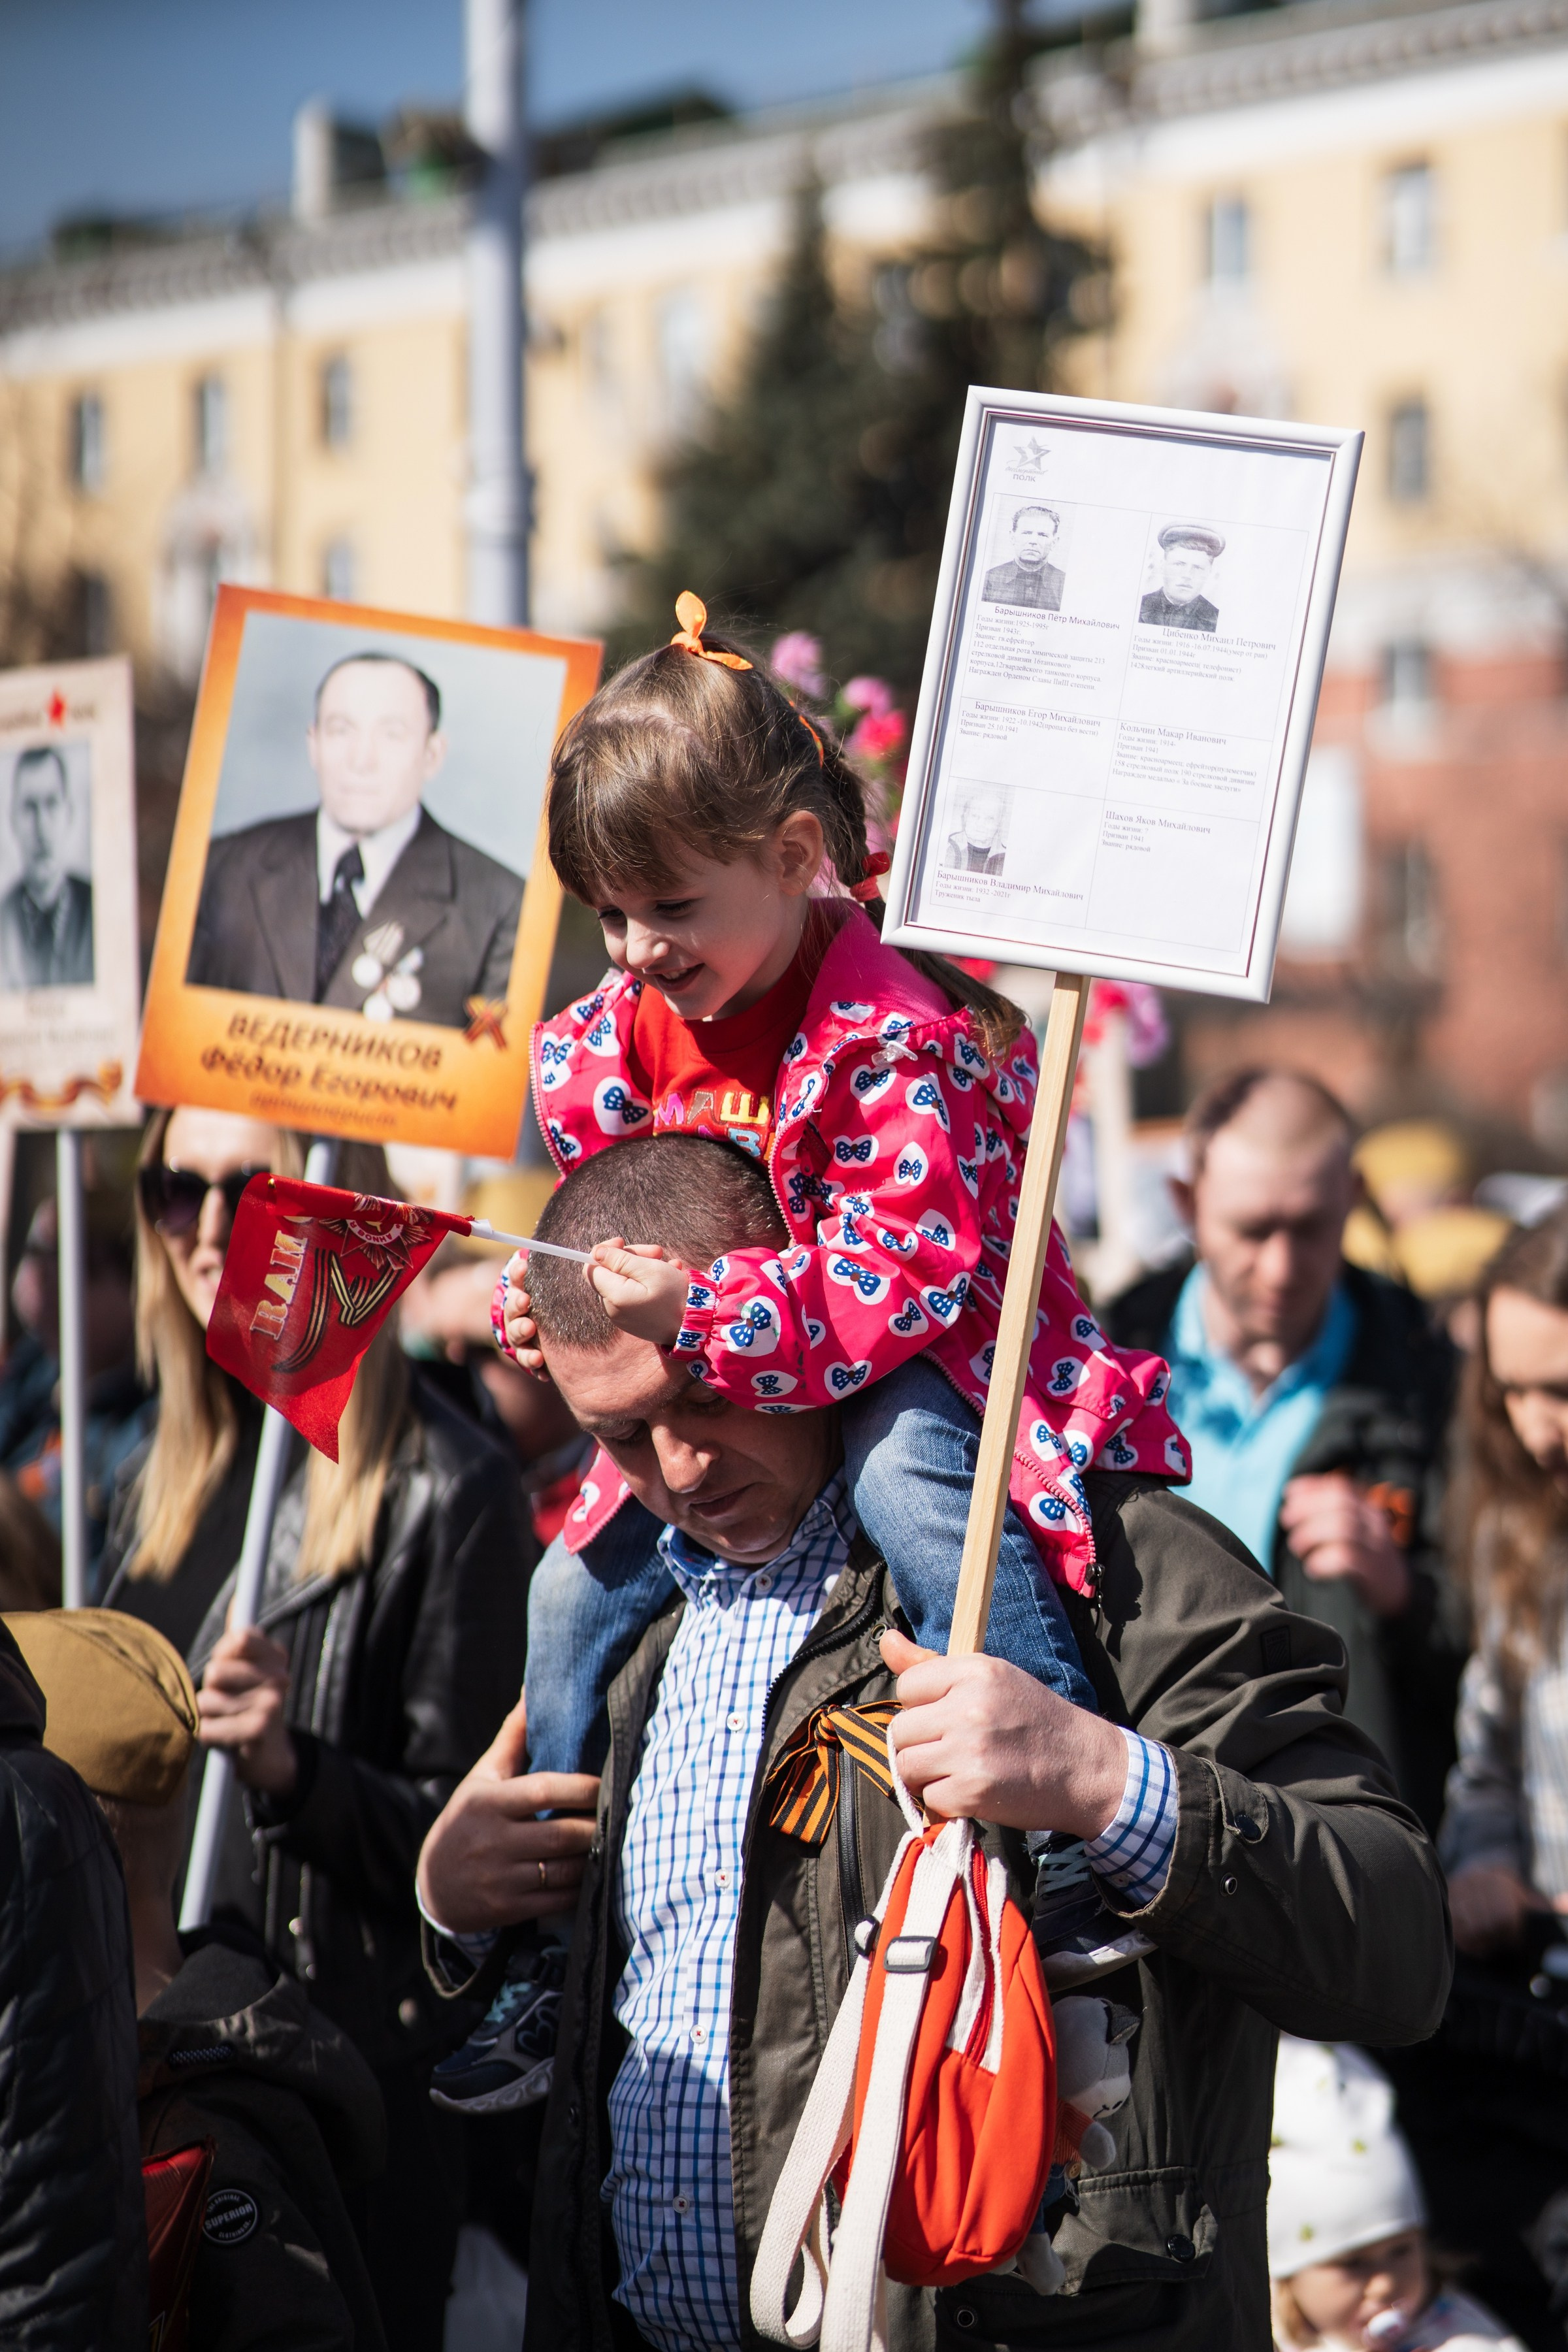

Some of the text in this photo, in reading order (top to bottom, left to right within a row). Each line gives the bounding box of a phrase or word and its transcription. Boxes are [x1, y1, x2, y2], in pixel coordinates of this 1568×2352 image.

[1013, 473, 1036, 482] ПОЛК
[994, 606, 1120, 630] Барышников Пётр Михайлович
[1162, 628, 1276, 651] Цибенко Михаил Петрович
[968, 666, 1002, 678] Награжден
[1002, 671, 1031, 682] Орденом
[974, 701, 1101, 727] Барышников Егор Михайлович
[1120, 722, 1227, 745] Кольчин Макар Иванович
[1112, 768, 1147, 779] Награжден
[1105, 810, 1211, 834] Шахов Яков Михайлович
[934, 889, 965, 900] Труженик
[937, 870, 1084, 901] Барышников Владимир Михайлович
[228, 1011, 444, 1072] ВЕДЕРНИКОВ
[311, 1063, 457, 1111] Егорович
[654, 1090, 776, 1127] МАШ
[214, 2195, 240, 2204] ORIGINAL
[204, 2203, 253, 2229] SUPERIOR
[220, 2228, 244, 2238] CLOTHING
